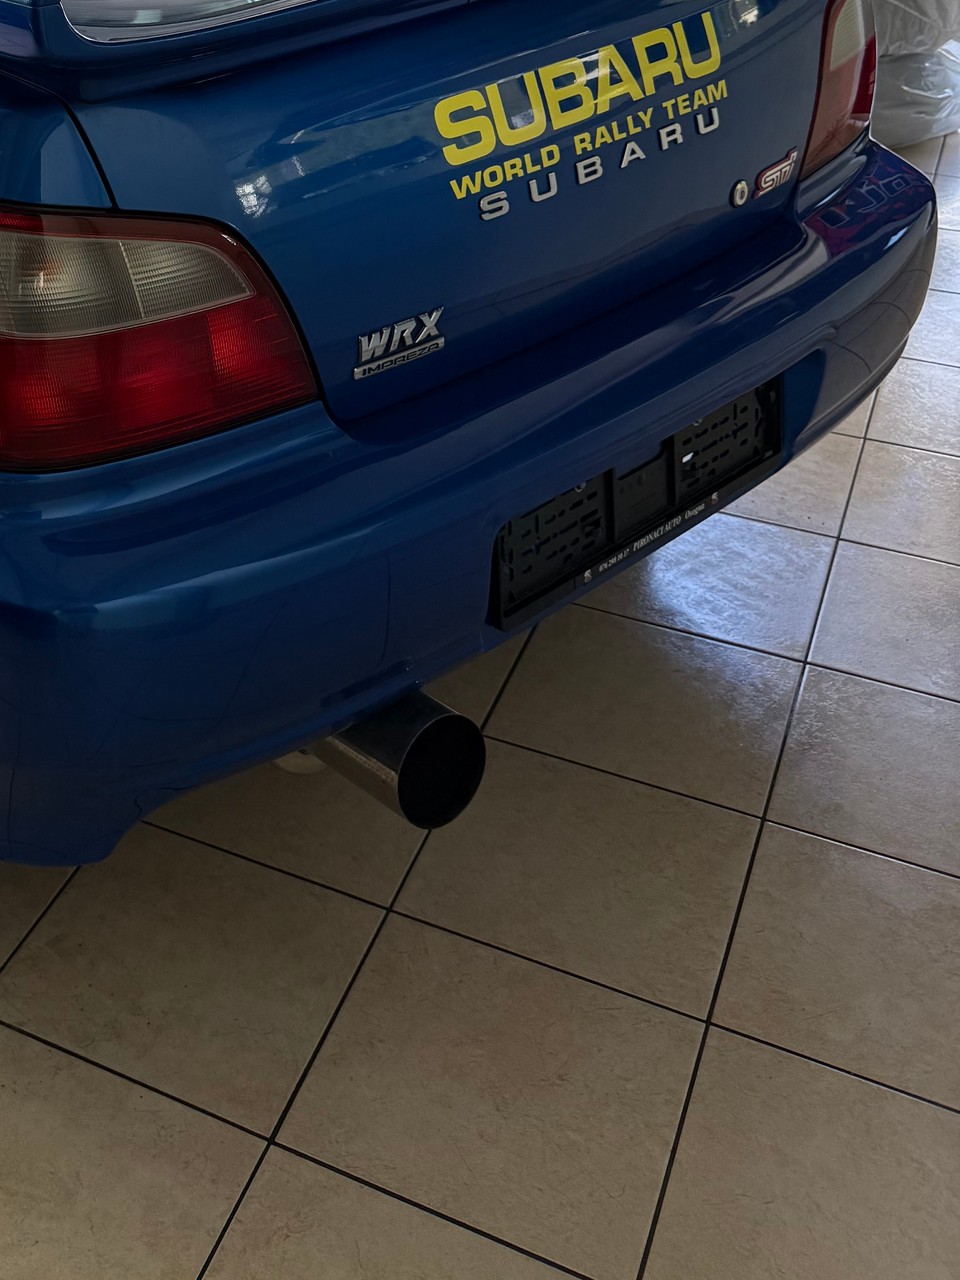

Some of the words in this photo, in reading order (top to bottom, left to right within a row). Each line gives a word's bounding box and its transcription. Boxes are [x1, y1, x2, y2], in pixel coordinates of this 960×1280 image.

[434, 12, 722, 166] SUBARU
[449, 144, 560, 200] WORLD
[573, 107, 654, 156] RALLY
[662, 80, 728, 120] TEAM
[479, 107, 720, 221] SUBARU
[358, 307, 444, 364] WRX
[360, 341, 440, 378] IMPREZA
